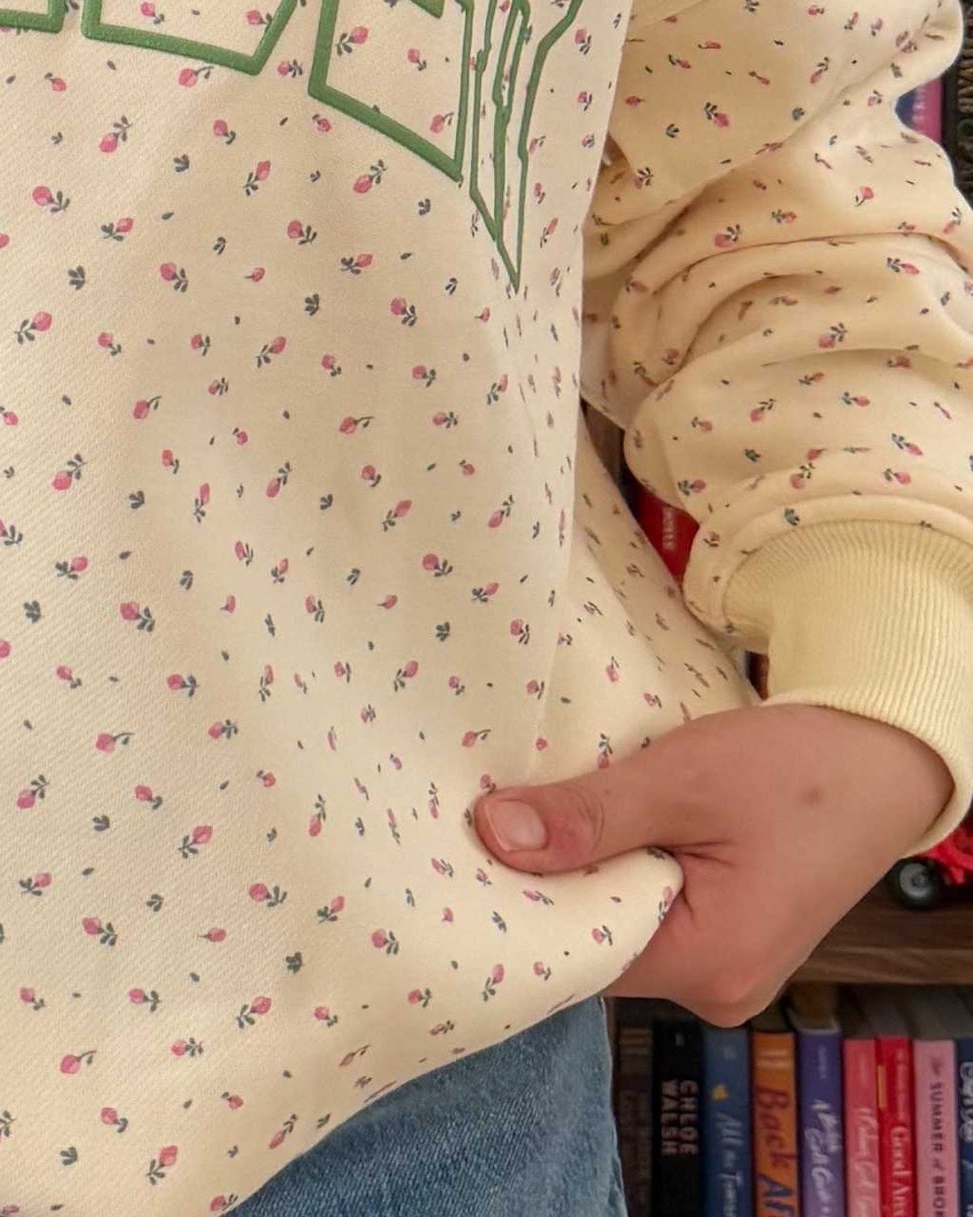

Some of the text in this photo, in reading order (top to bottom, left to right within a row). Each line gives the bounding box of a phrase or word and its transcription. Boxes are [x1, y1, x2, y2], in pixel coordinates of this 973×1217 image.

[660, 1080, 679, 1156] WALSH
[680, 1080, 699, 1156] CHLOE
[755, 1086, 796, 1169] Back
[930, 1081, 945, 1152] SUMMER
